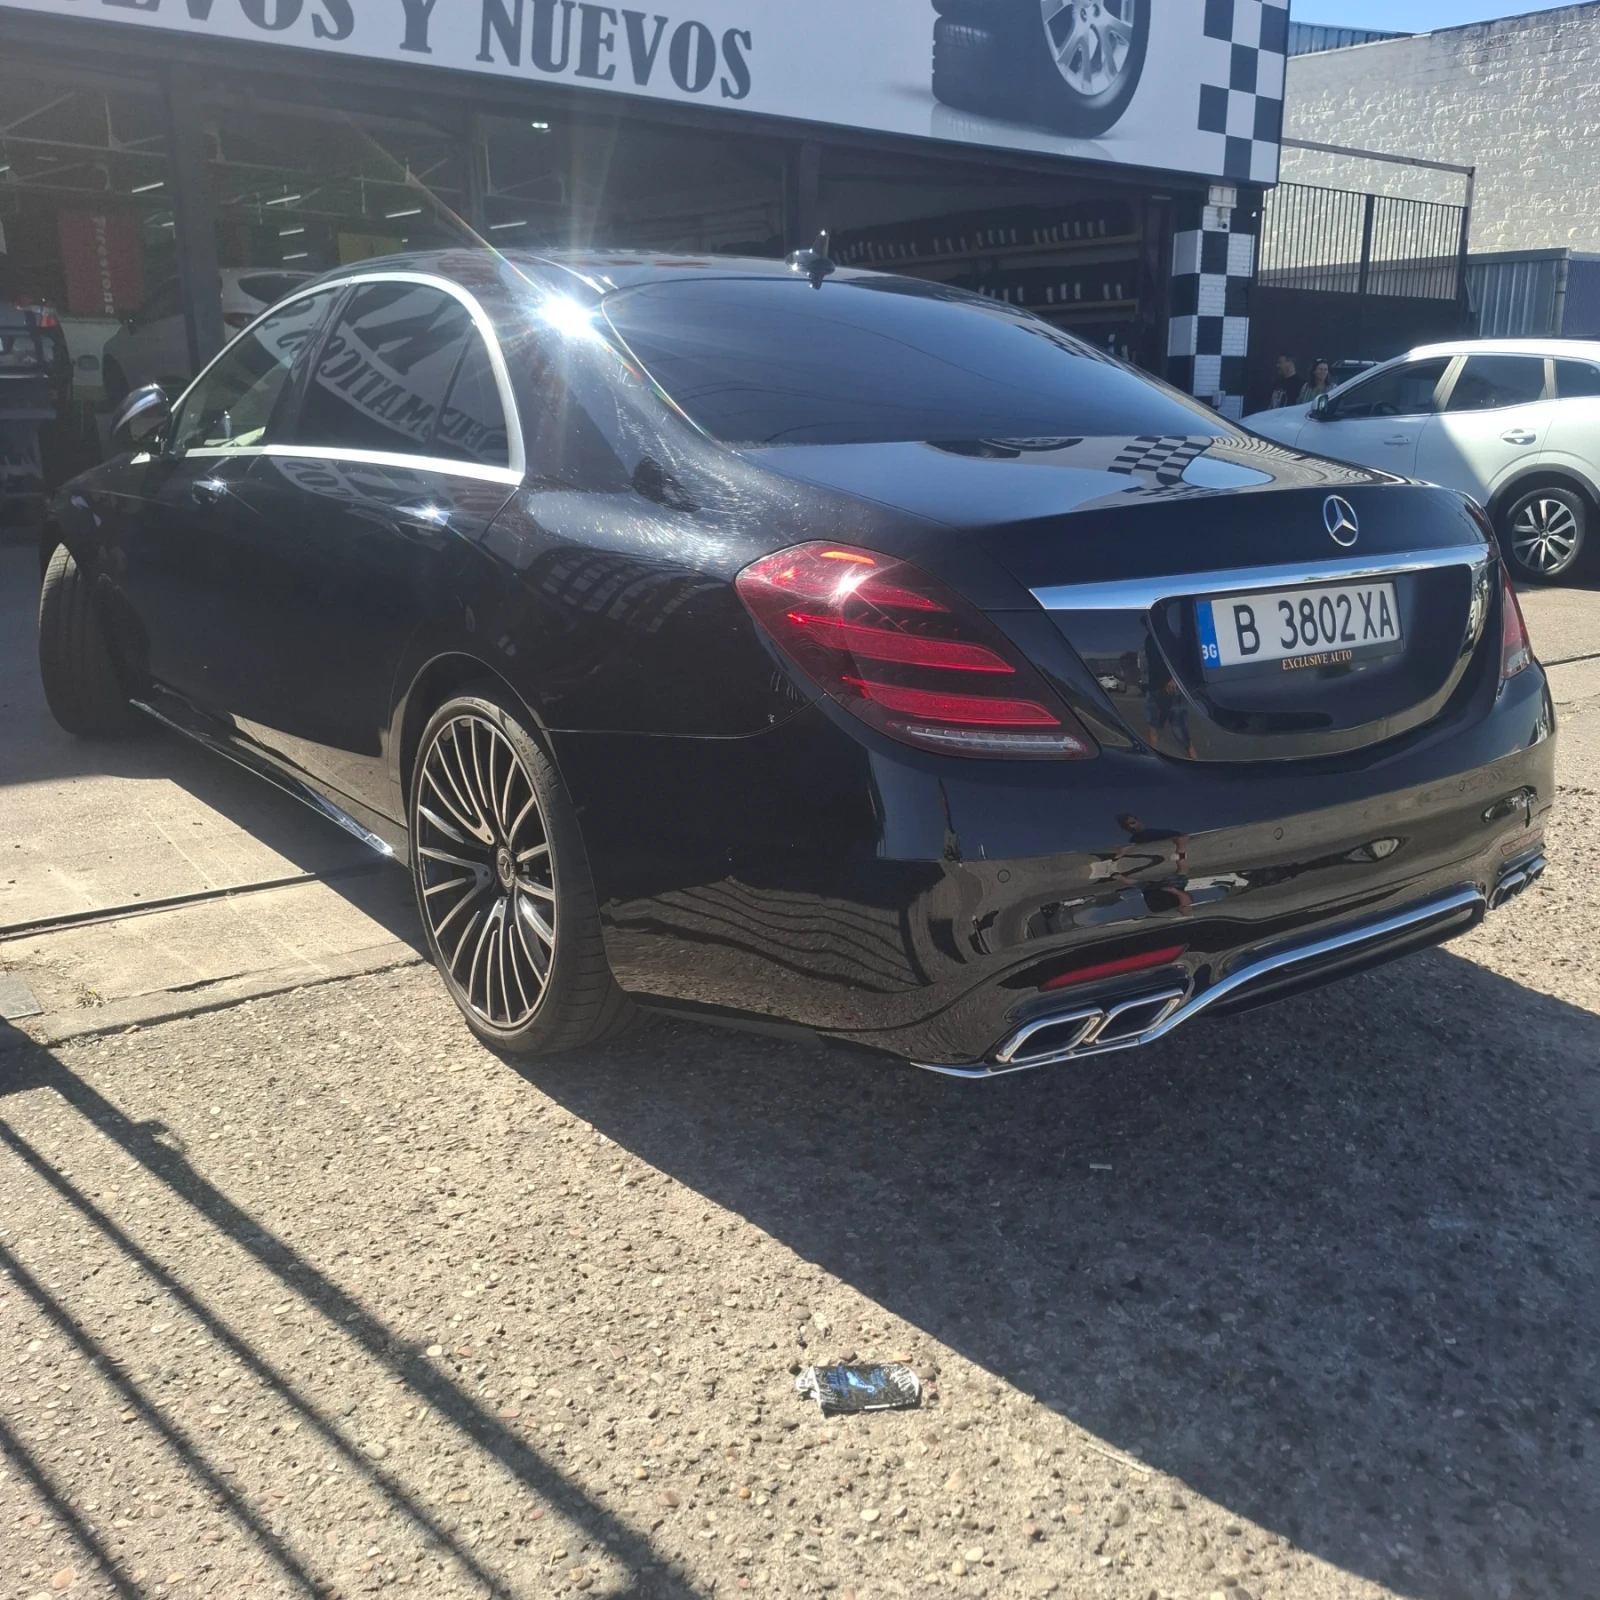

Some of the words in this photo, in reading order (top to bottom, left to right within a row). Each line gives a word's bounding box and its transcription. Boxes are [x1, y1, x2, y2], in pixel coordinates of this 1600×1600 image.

[400, 0, 438, 54] Y
[475, 0, 753, 100] NUEVOS
[1233, 604, 1260, 656] B
[1282, 652, 1328, 671] EXCLUSIVE
[1329, 649, 1353, 666] AUTO
